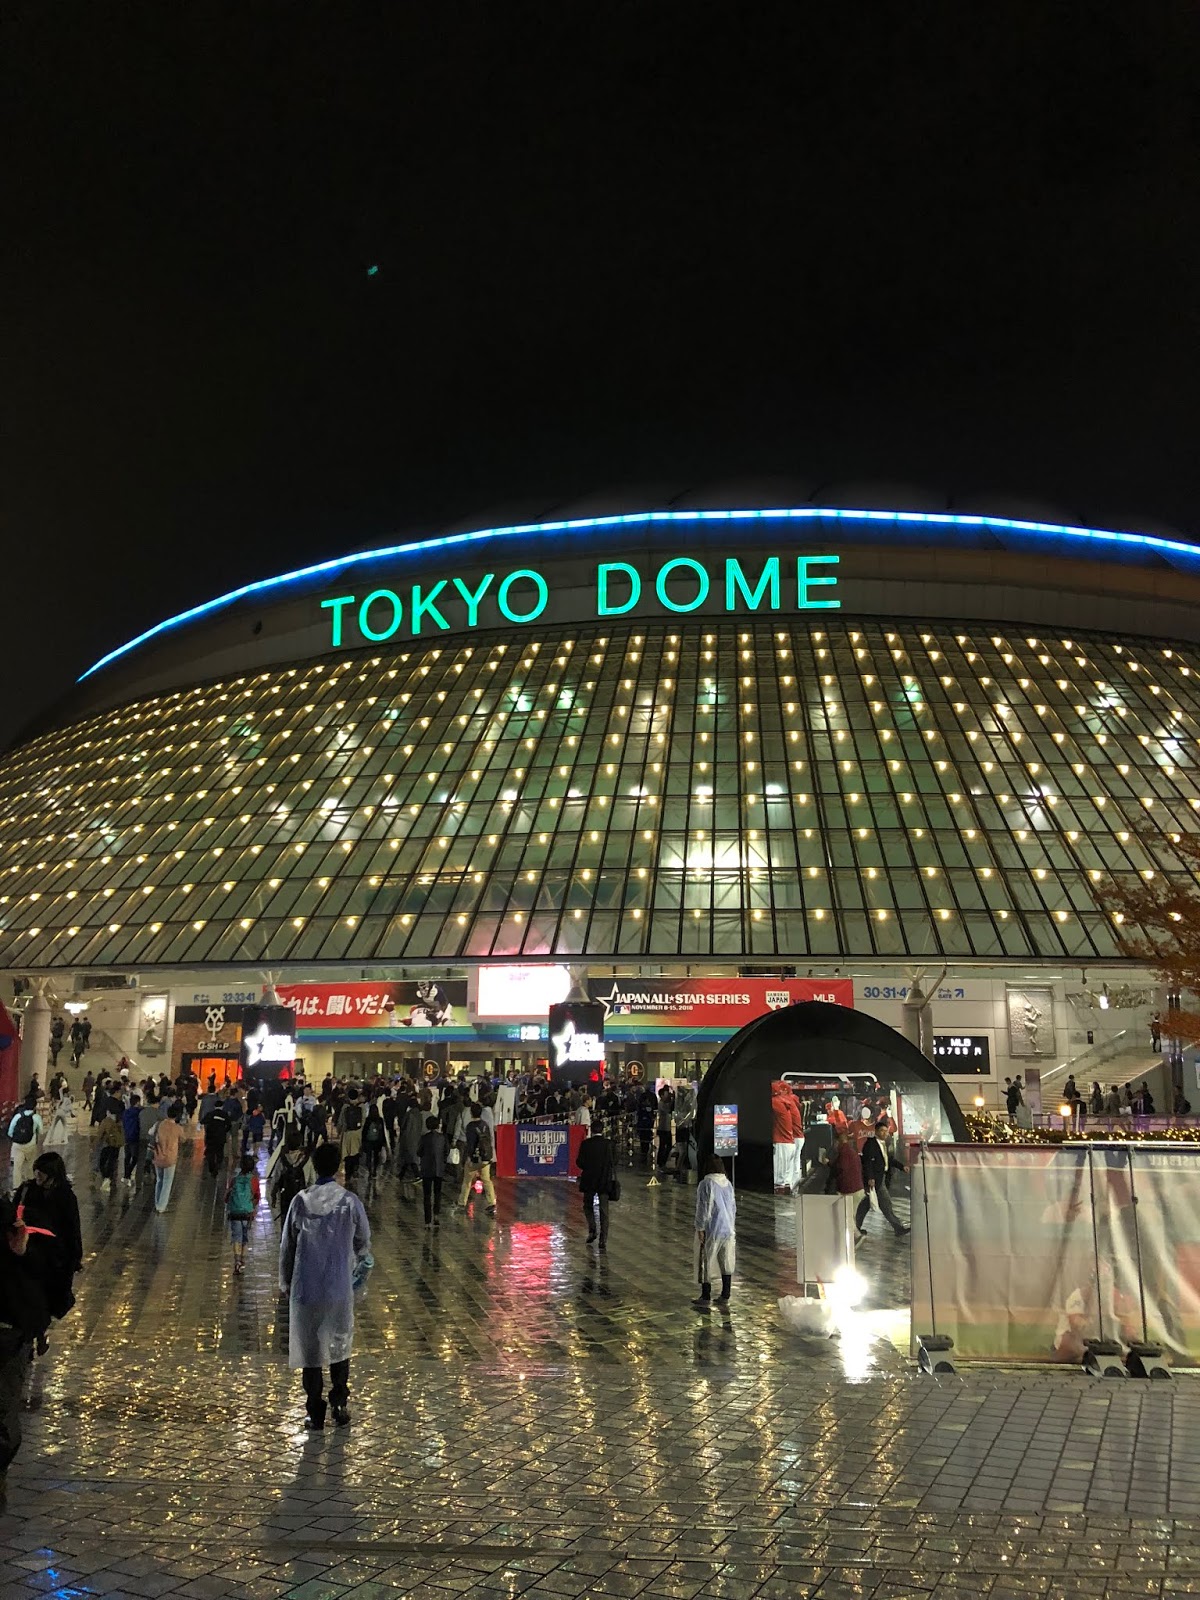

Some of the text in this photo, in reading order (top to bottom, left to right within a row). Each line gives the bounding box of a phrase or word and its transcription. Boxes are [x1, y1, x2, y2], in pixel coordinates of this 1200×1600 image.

[321, 555, 842, 647] TOKYO DOME
[614, 994, 650, 1004] JAPAN
[706, 994, 750, 1004] SERIES
[814, 994, 836, 1003] MLB
[950, 1038, 971, 1047] MLB
[520, 1131, 567, 1144] HOME RUN
[528, 1144, 558, 1156] DERBY
